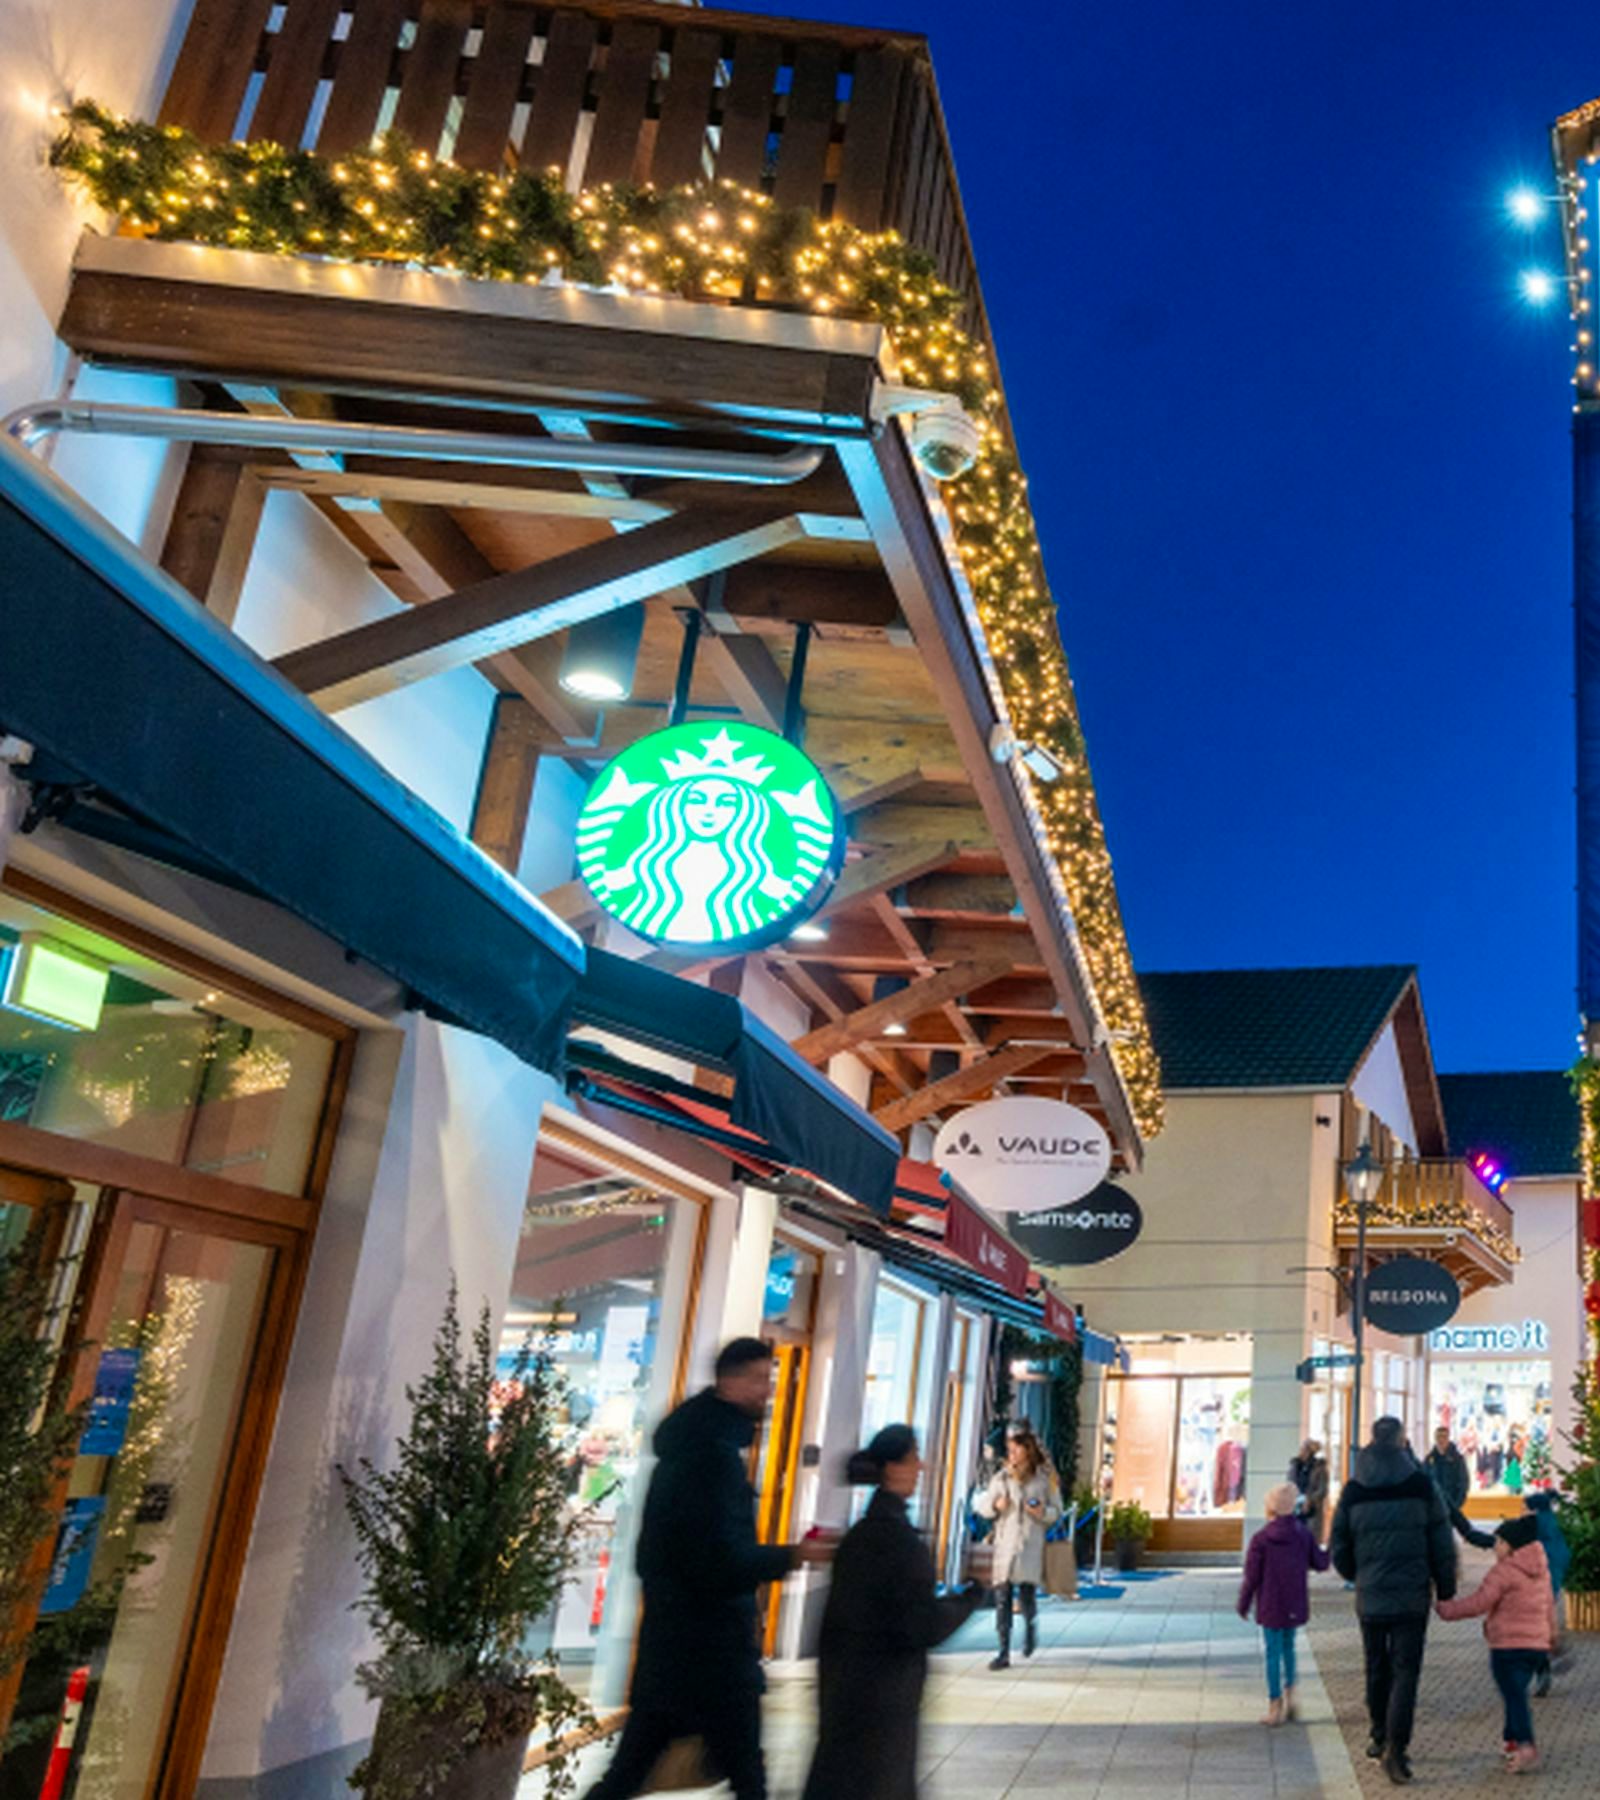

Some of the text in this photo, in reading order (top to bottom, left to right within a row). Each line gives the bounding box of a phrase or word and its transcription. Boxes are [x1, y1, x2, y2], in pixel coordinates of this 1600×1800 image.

[998, 1136, 1101, 1156] VAUDE
[1432, 1319, 1546, 1350] name it
